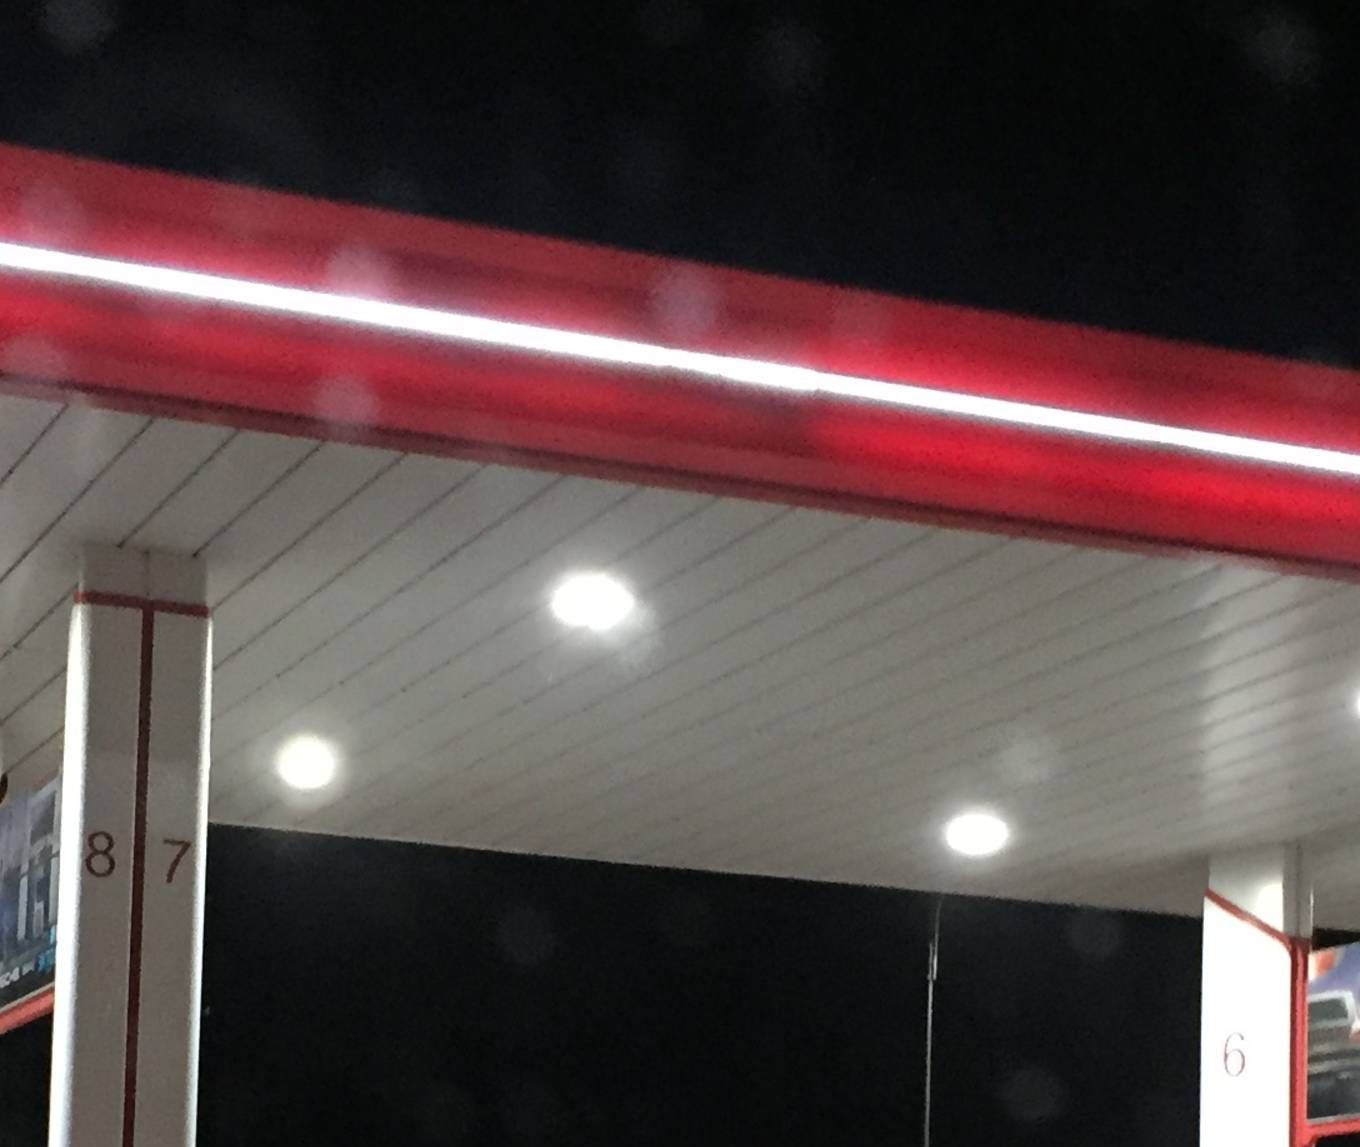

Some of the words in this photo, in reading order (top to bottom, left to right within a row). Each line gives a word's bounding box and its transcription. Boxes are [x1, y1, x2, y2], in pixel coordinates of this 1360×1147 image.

[85, 831, 116, 878] 8
[163, 839, 192, 883] 7
[1223, 1032, 1247, 1077] 6
